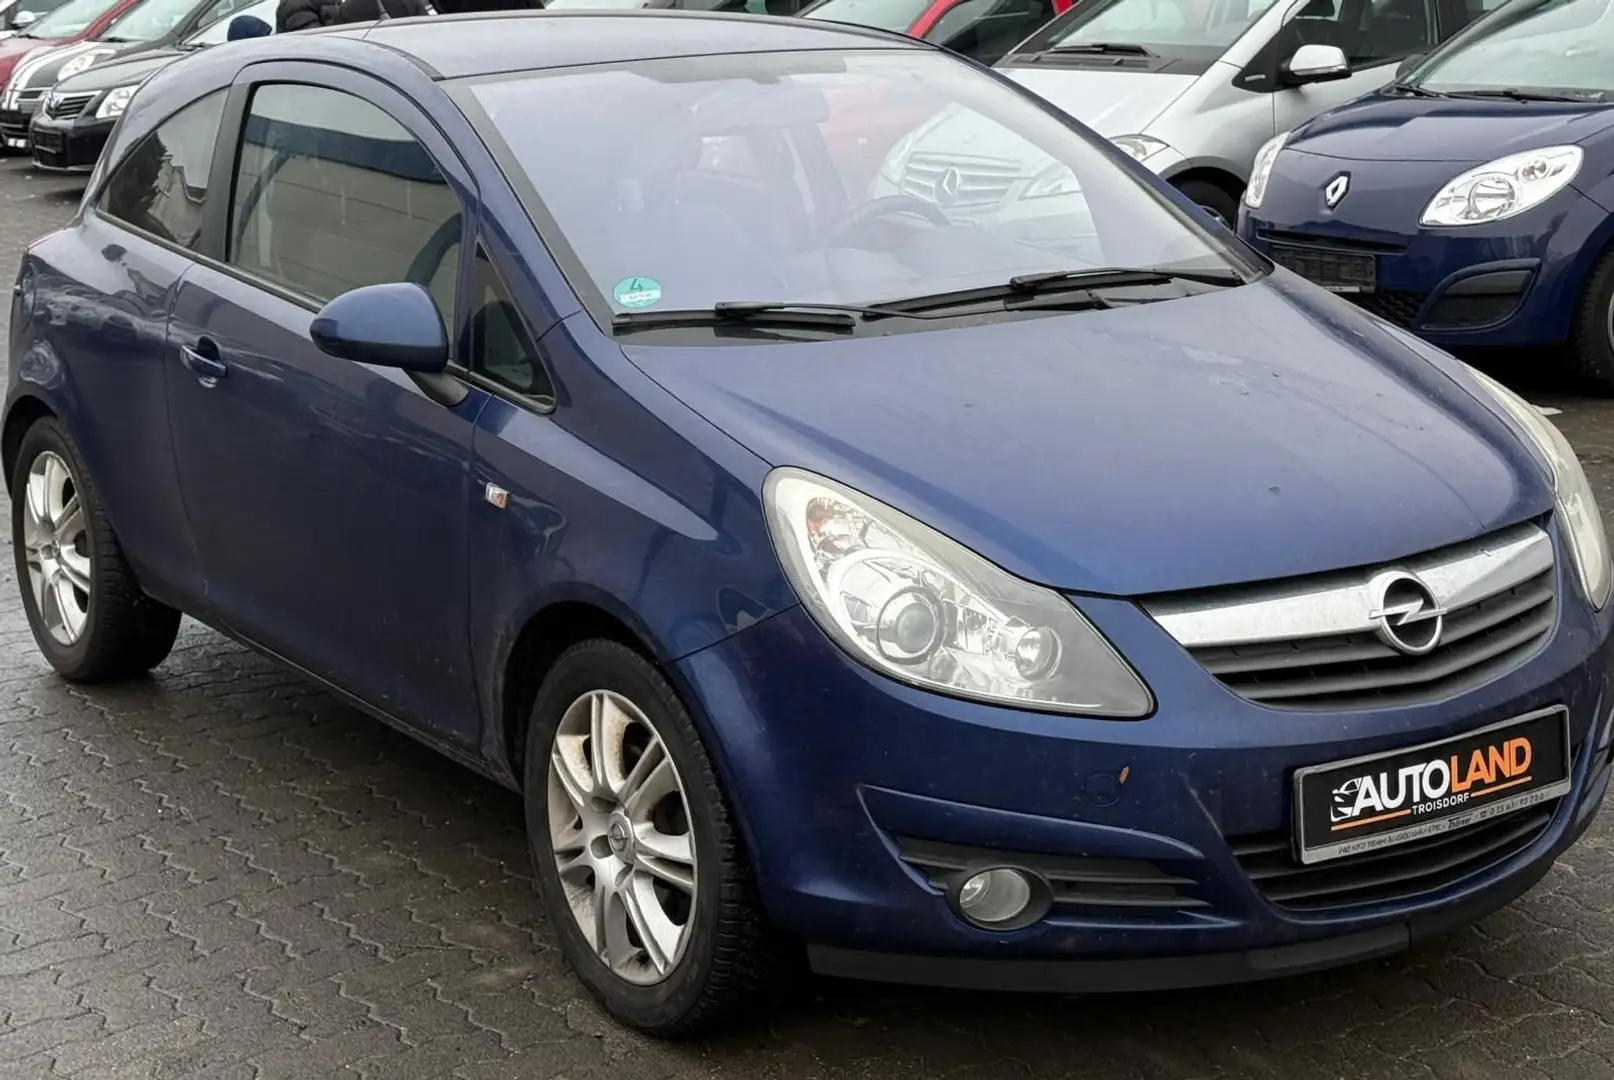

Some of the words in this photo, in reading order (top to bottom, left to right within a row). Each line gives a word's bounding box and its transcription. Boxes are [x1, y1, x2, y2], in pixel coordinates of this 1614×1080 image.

[629, 278, 645, 292] 4
[1352, 737, 1532, 816] AUTOLAND
[1412, 792, 1470, 815] TROISDORF
